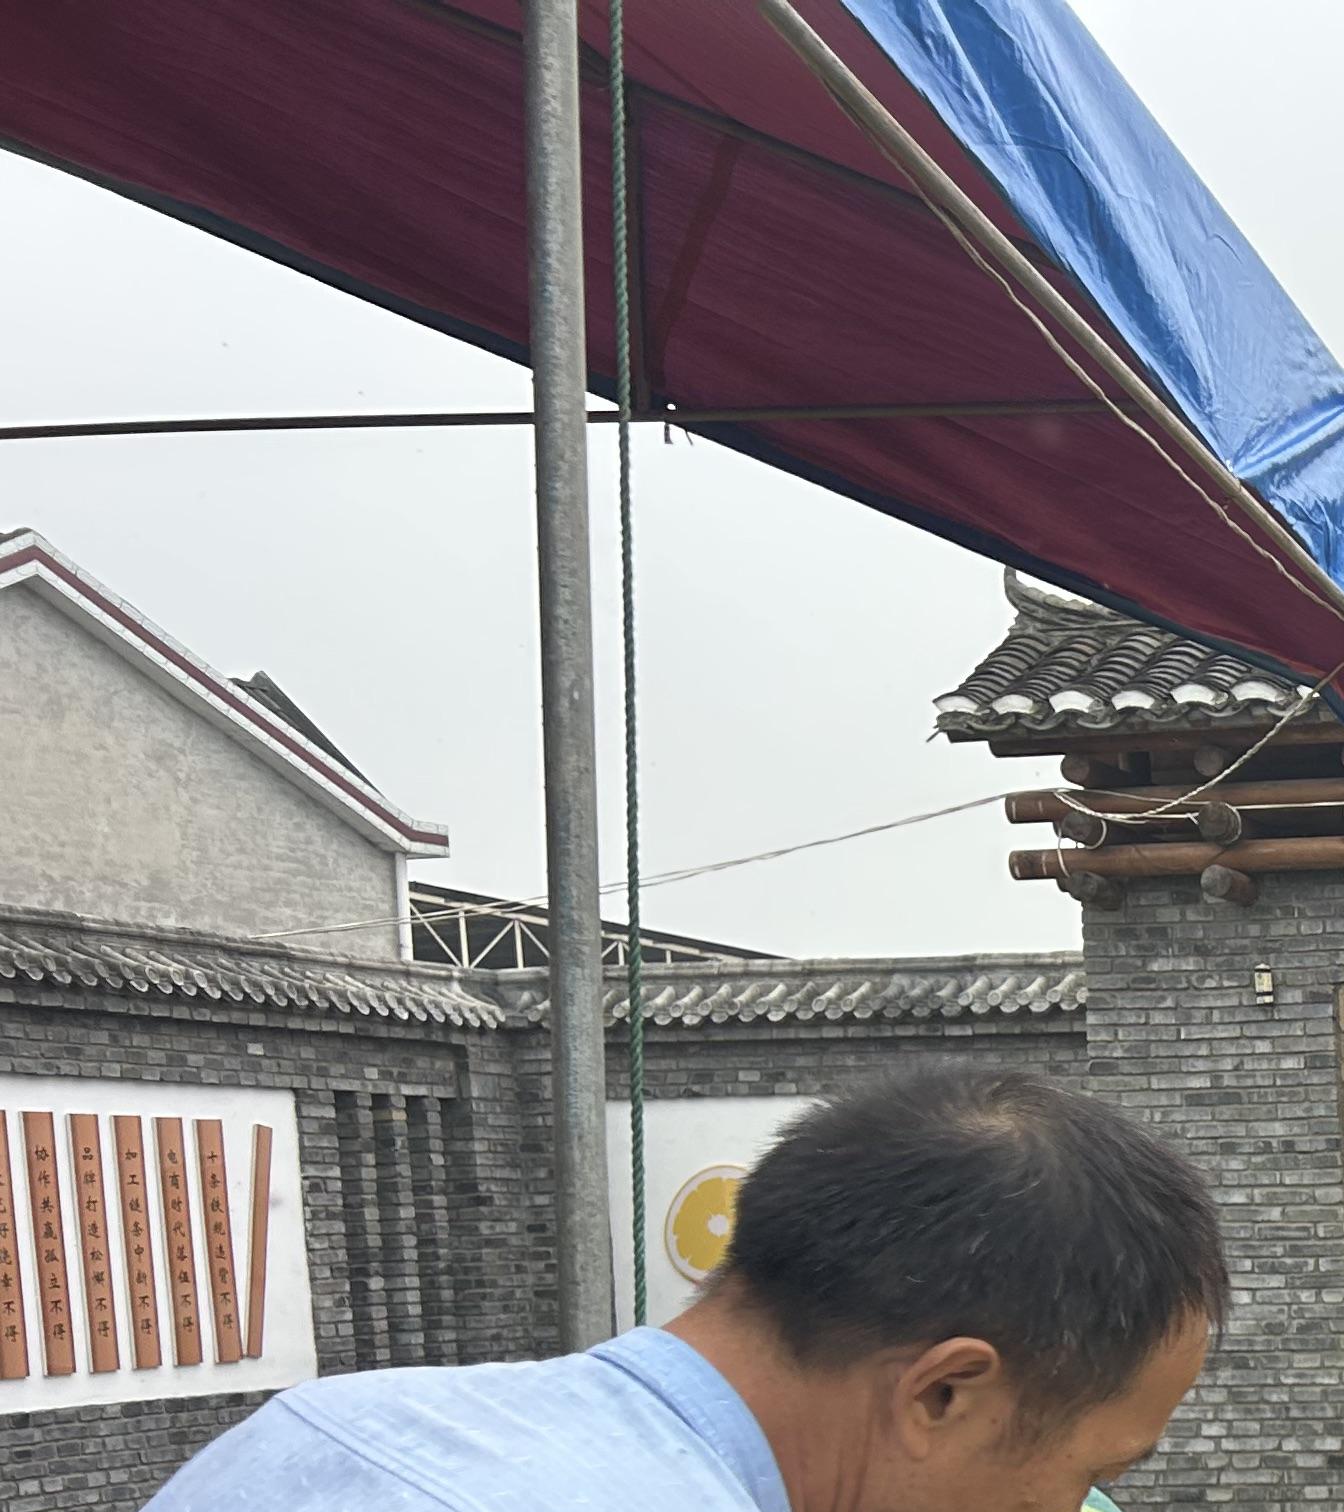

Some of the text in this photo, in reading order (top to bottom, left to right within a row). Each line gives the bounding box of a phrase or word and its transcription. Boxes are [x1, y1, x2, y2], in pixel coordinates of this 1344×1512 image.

[34, 1145, 67, 1340] 协作共赢孤立不得
[82, 1146, 109, 1337] 品牌打造松懈不得
[124, 1148, 152, 1335] 加工链条中断不得
[167, 1149, 194, 1332] 电商时代落伍不得
